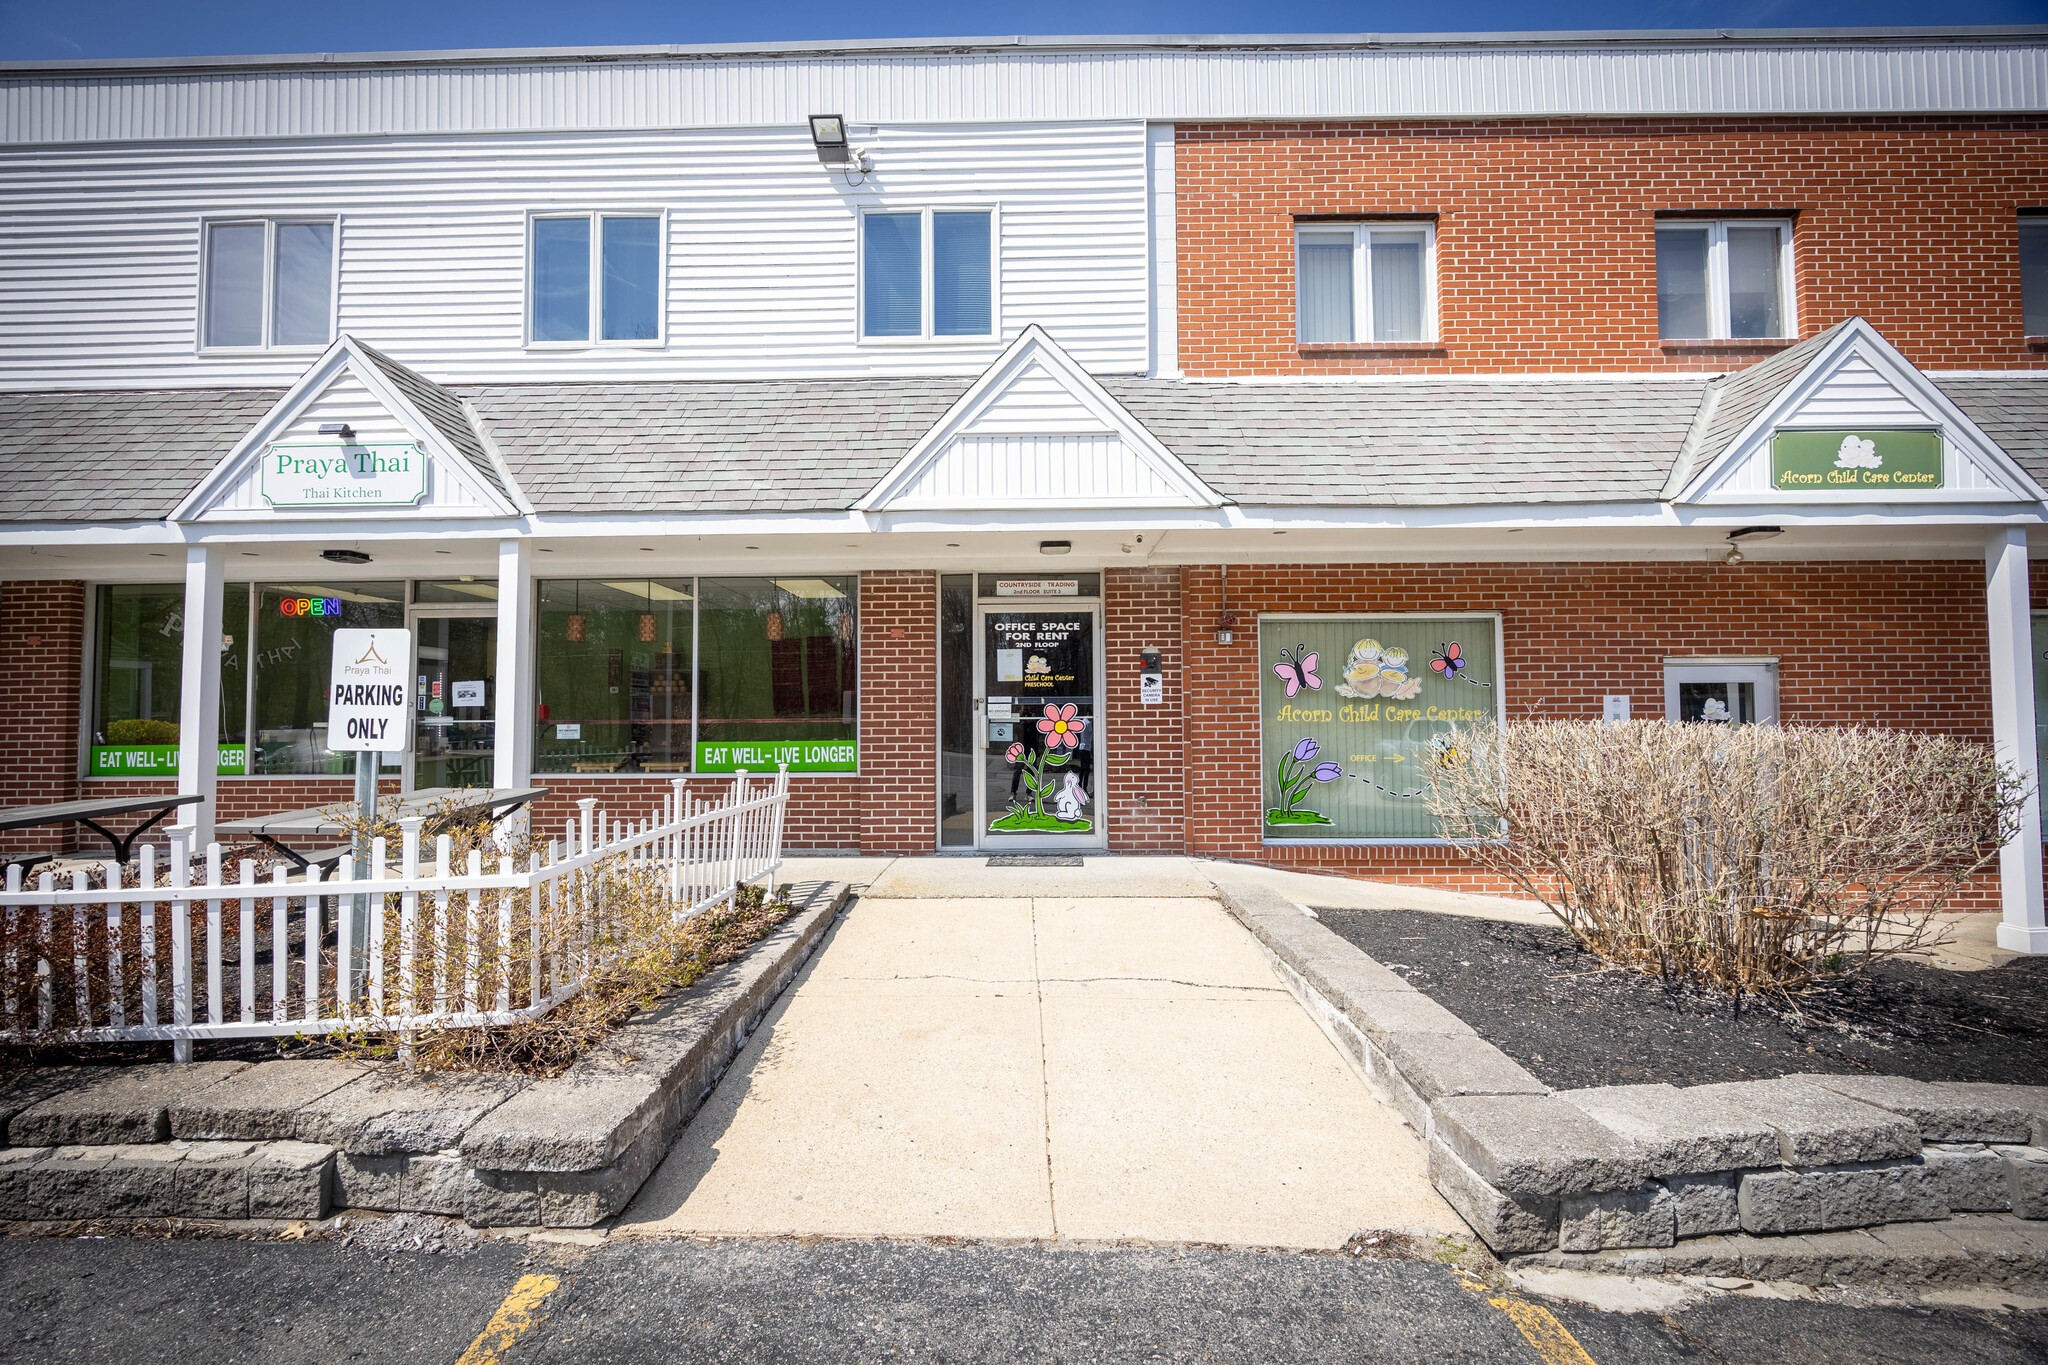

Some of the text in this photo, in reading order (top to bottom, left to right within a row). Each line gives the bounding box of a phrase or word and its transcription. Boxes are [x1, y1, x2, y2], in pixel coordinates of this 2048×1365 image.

[276, 450, 410, 480] Praya Thai
[1780, 469, 1935, 484] Acorn Child Care Center
[303, 486, 382, 499] Thai Kitchen
[280, 597, 341, 617] OPEN
[994, 622, 1080, 631] OFFICE SPACE
[1005, 632, 1069, 640] FOR RENT
[344, 665, 392, 676] Praya Thai
[335, 684, 403, 706] PARKING
[1276, 703, 1482, 723] Acorn Child Care Center
[347, 717, 388, 739] ONLY
[100, 751, 122, 768] EAT
[705, 747, 728, 764] EAT
[805, 746, 855, 763] LONGER
[1350, 754, 1377, 762] OFFICE
